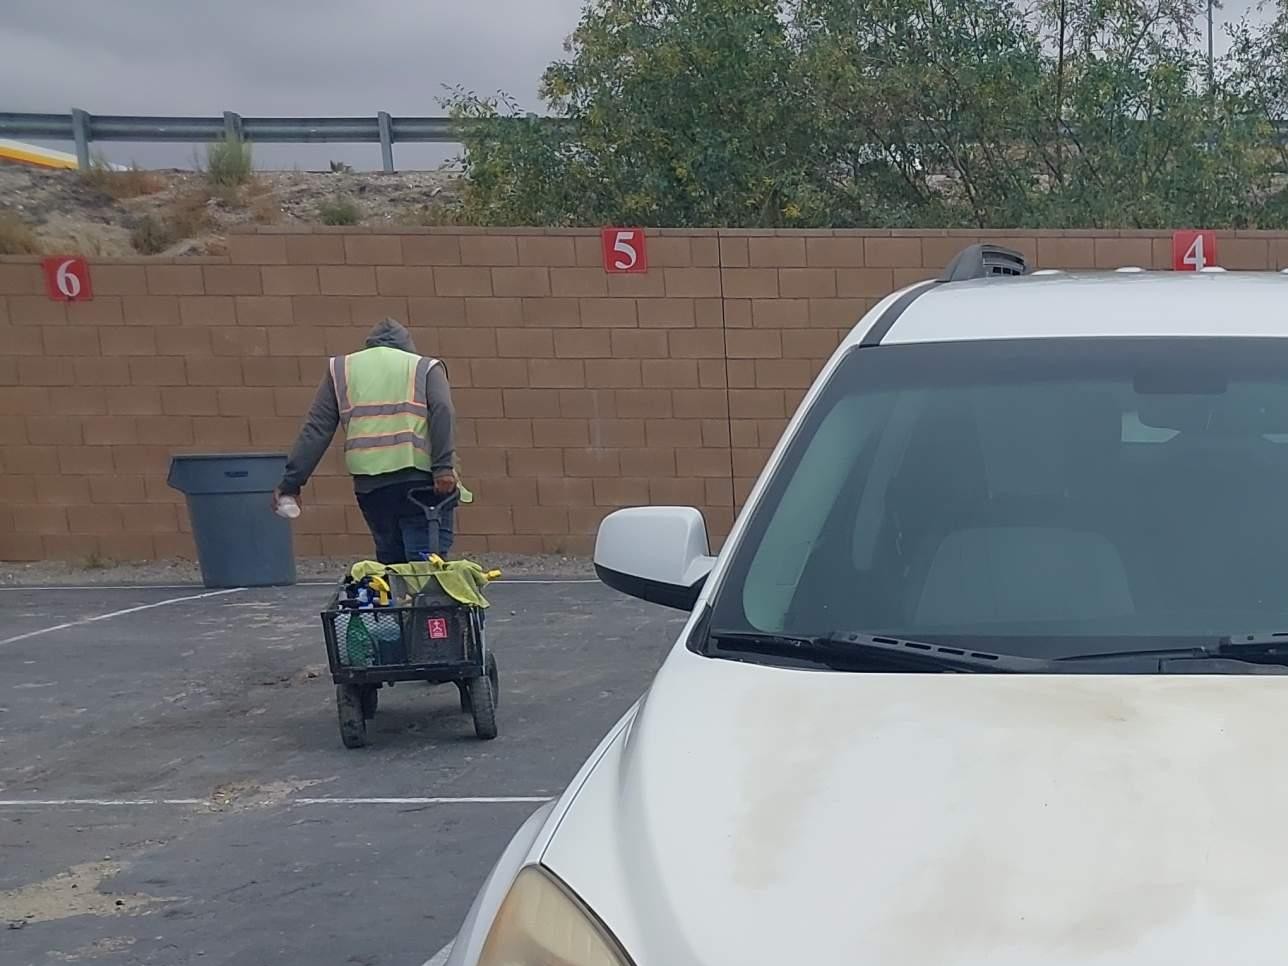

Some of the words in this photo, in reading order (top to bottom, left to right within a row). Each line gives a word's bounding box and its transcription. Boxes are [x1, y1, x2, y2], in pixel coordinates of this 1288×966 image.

[614, 231, 637, 269] 5
[1183, 234, 1207, 272] 4
[57, 259, 80, 297] 6
